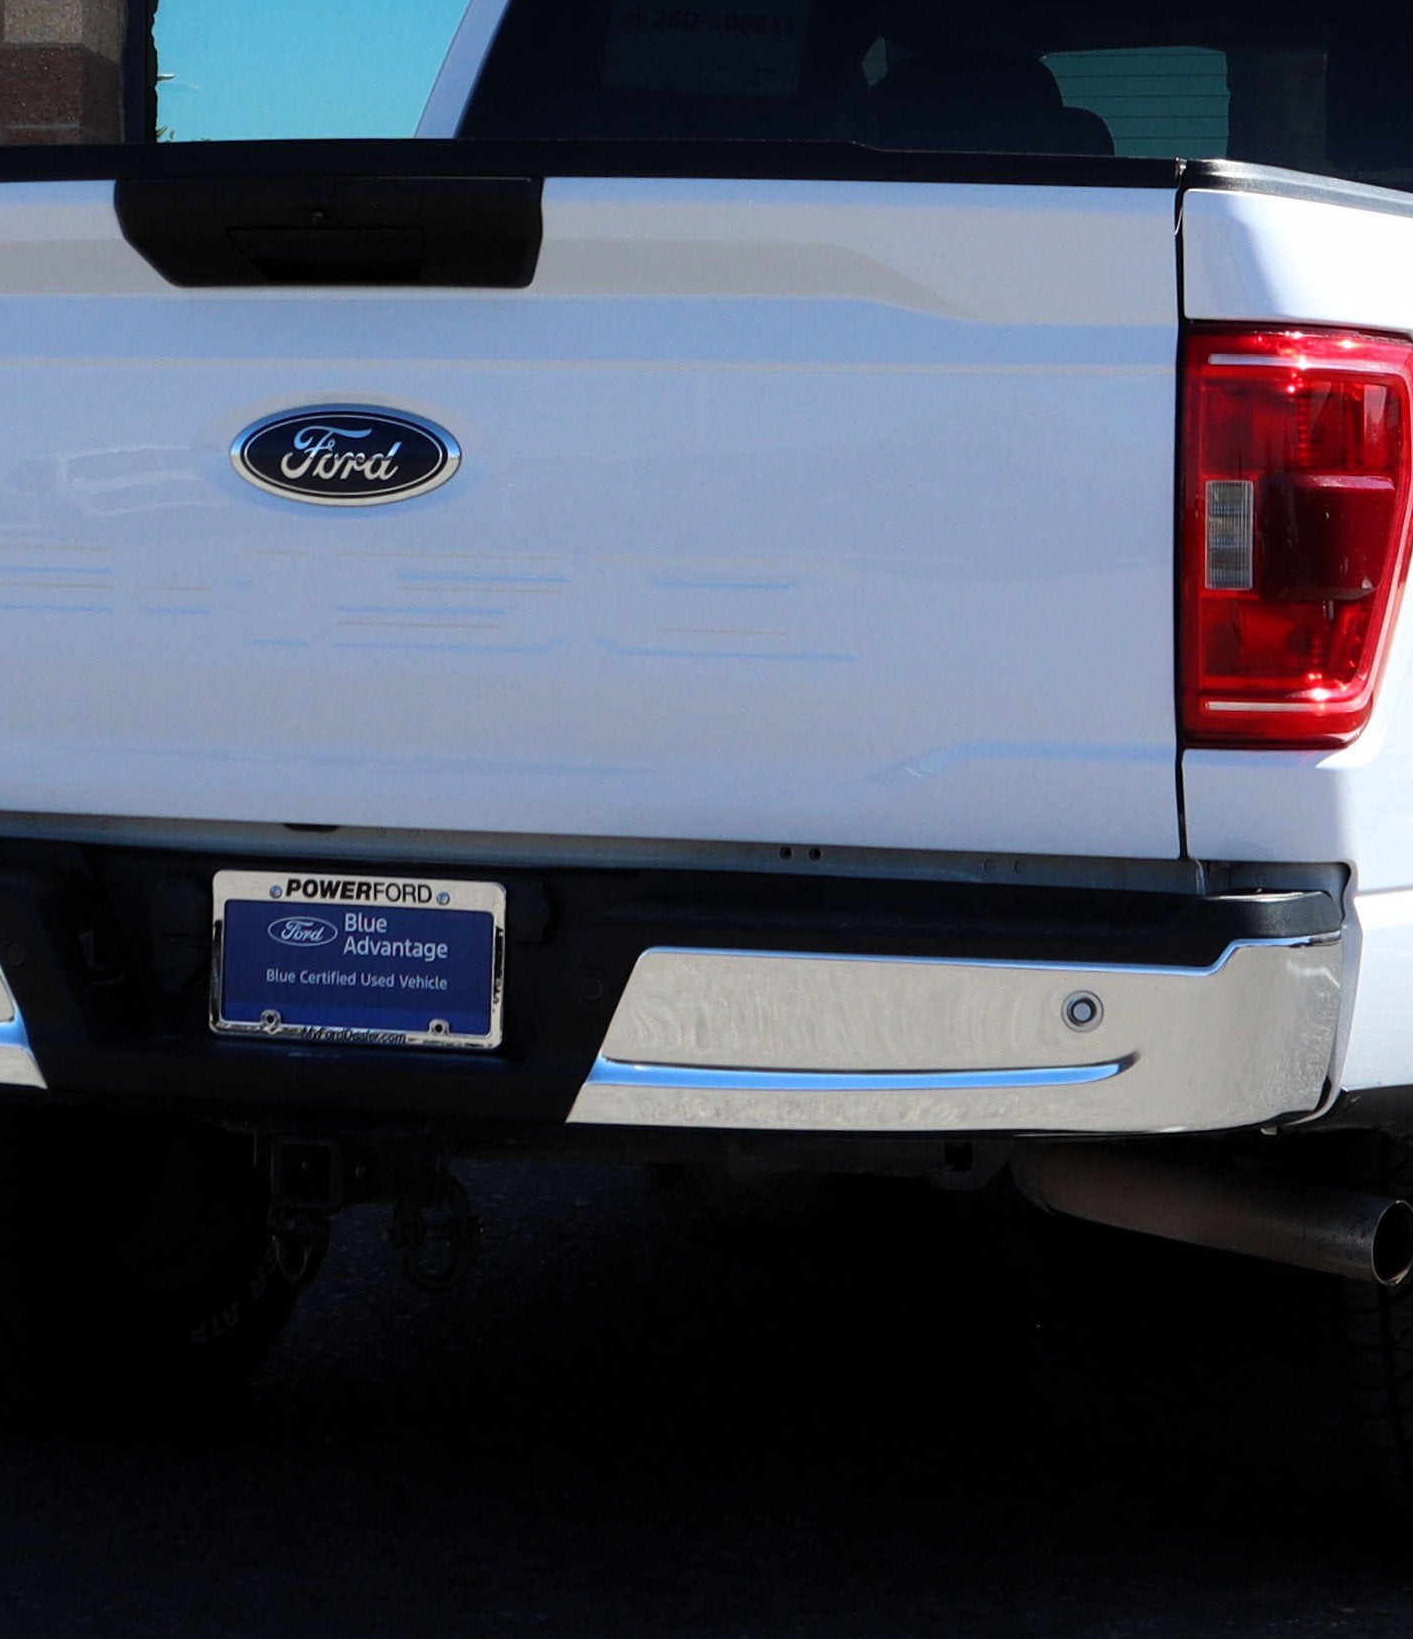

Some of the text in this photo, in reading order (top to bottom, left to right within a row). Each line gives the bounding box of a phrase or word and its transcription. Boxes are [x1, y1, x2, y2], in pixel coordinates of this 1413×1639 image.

[281, 425, 402, 481] Ford
[286, 879, 432, 903] POWERFORD
[281, 921, 324, 941] Ford
[345, 913, 387, 933] Blue
[343, 936, 448, 962] Advantage
[266, 969, 447, 991] Blue Certified Used Vehicle
